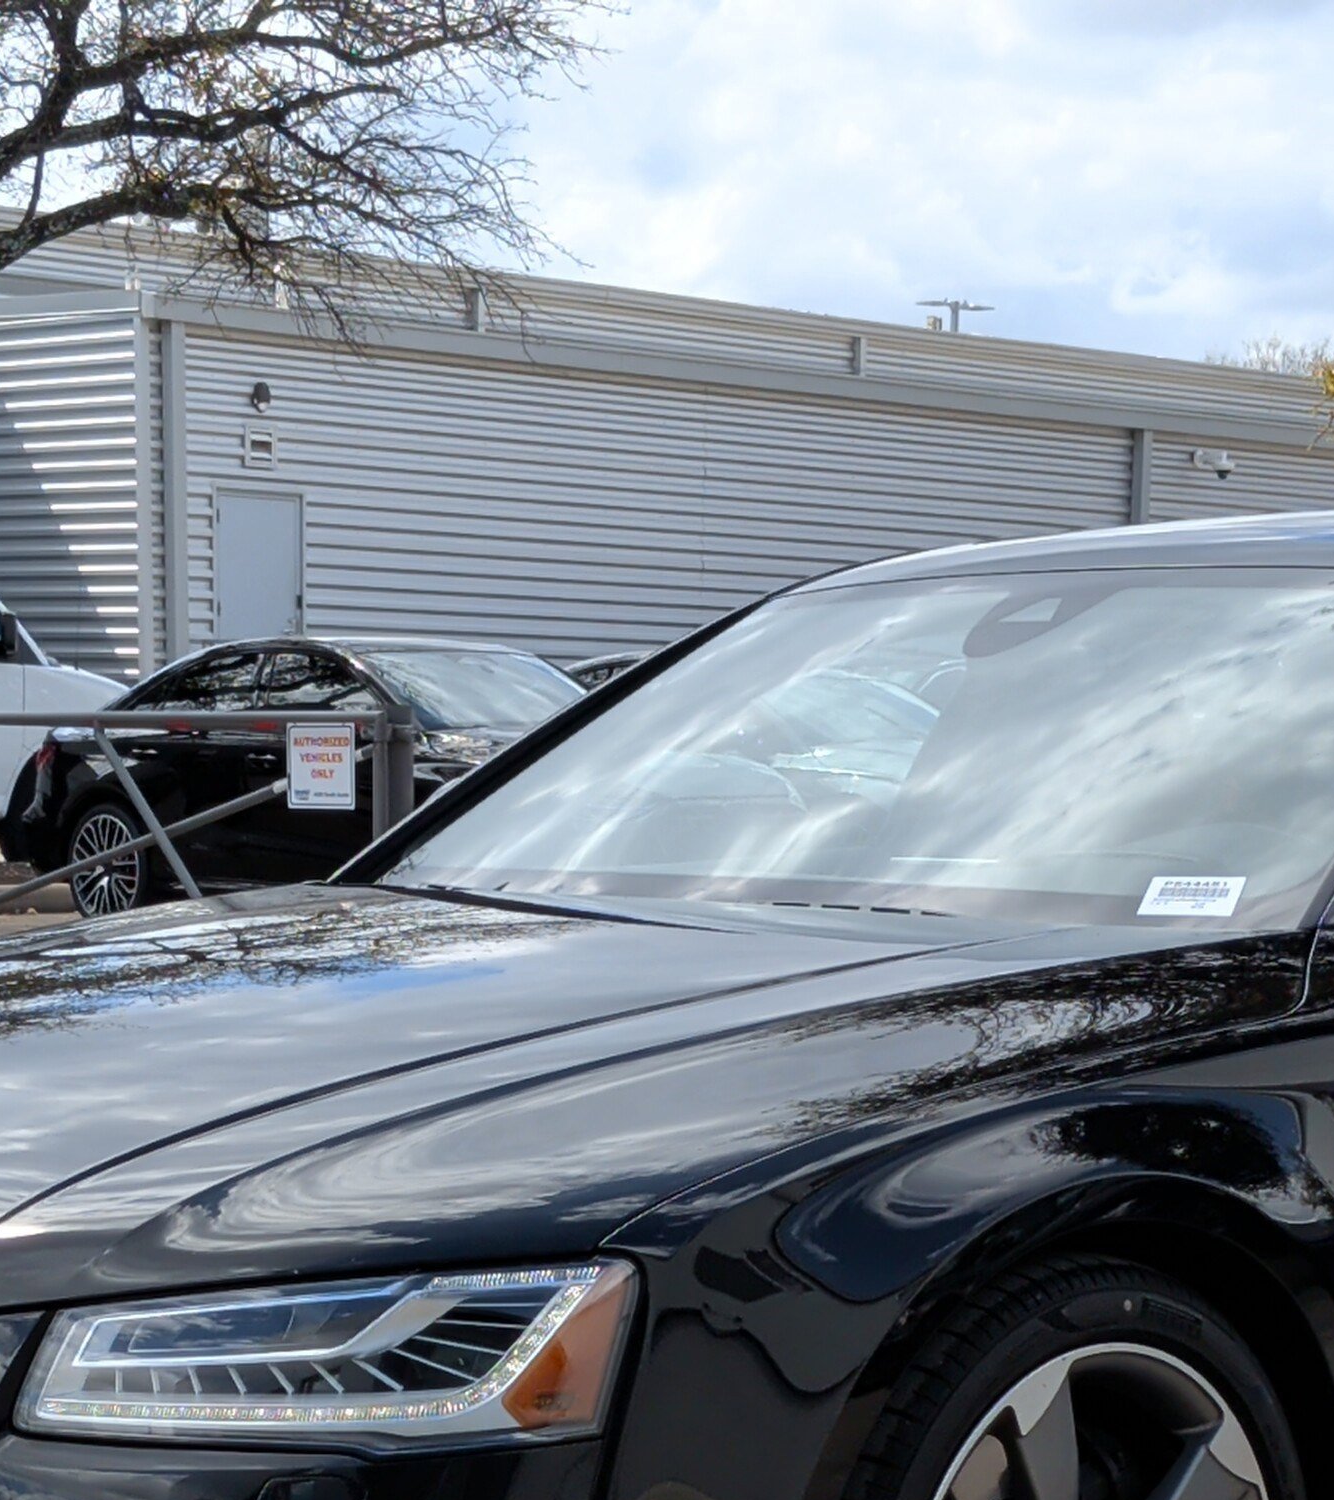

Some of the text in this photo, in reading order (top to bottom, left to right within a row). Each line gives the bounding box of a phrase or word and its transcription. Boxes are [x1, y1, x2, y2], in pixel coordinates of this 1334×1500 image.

[293, 736, 351, 747] AUTHORIZED
[299, 753, 344, 763] VEHICLES
[310, 769, 335, 779] ONLY
